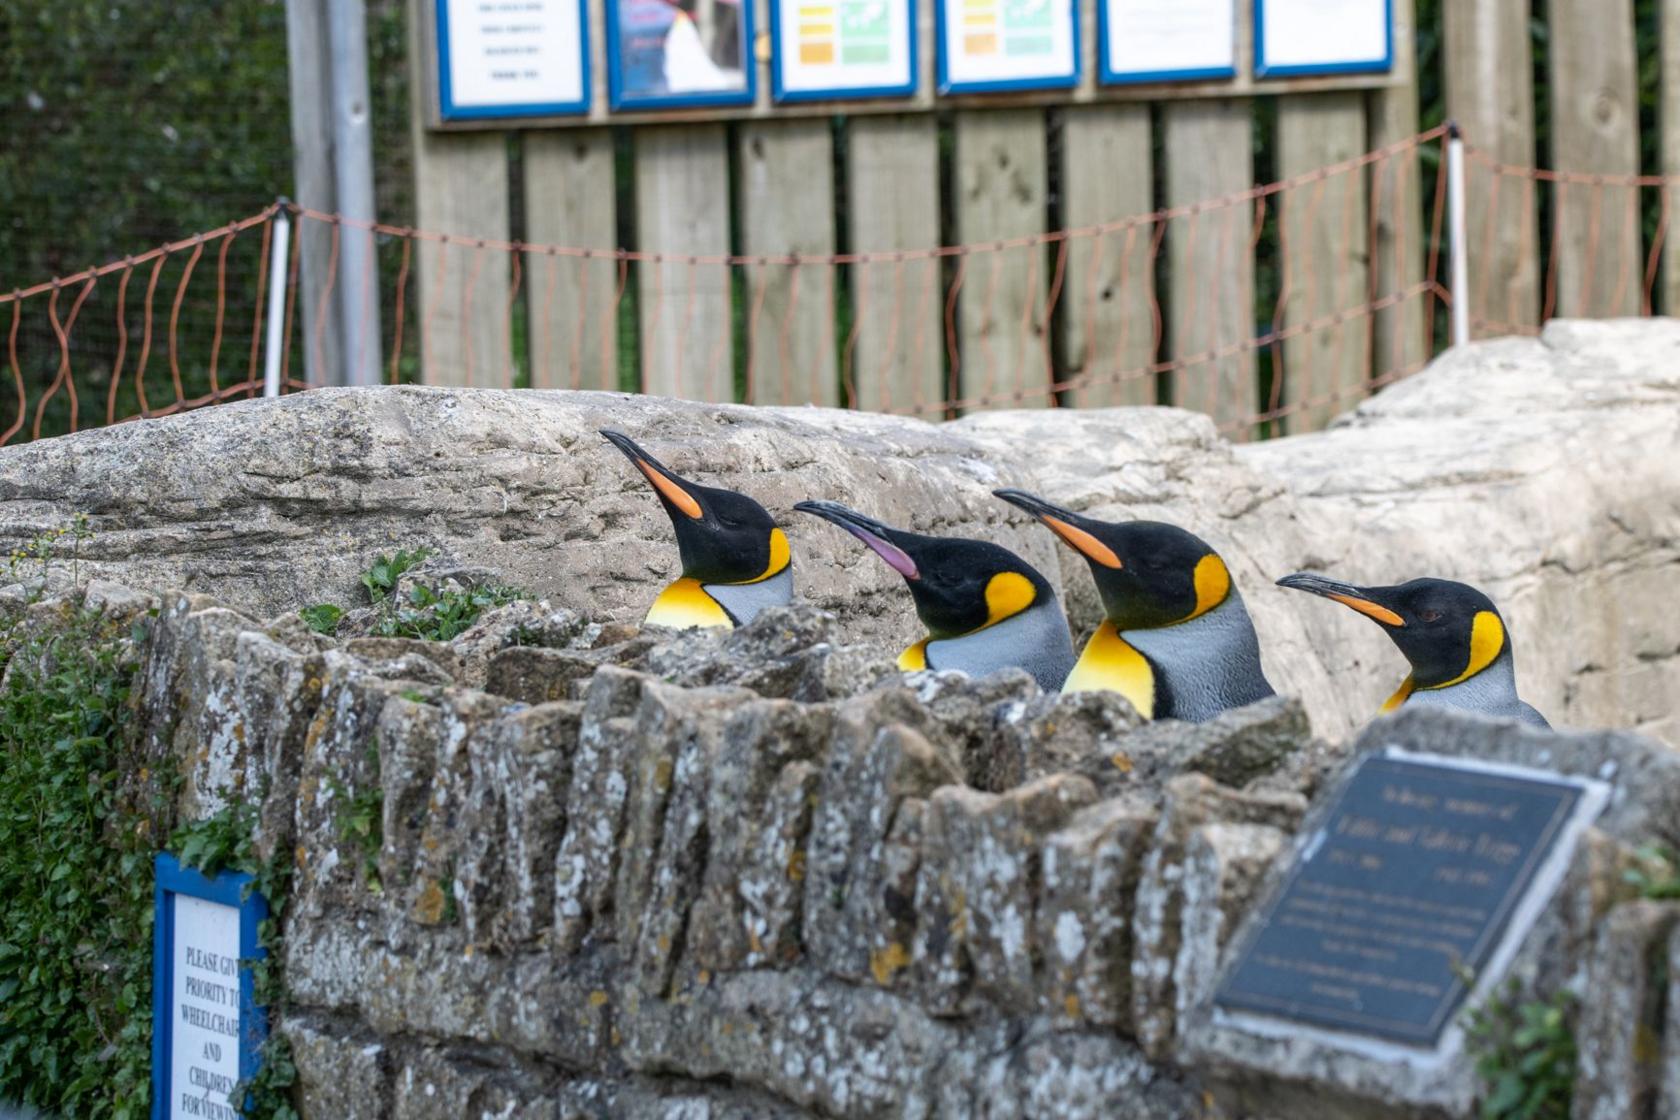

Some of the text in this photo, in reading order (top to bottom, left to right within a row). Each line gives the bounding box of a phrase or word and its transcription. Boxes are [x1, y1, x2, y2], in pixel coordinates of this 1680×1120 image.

[186, 946, 218, 973] PLEASE
[185, 976, 227, 1005] PRIORITY
[202, 1041, 222, 1063] AND
[182, 1093, 200, 1115] FOR
